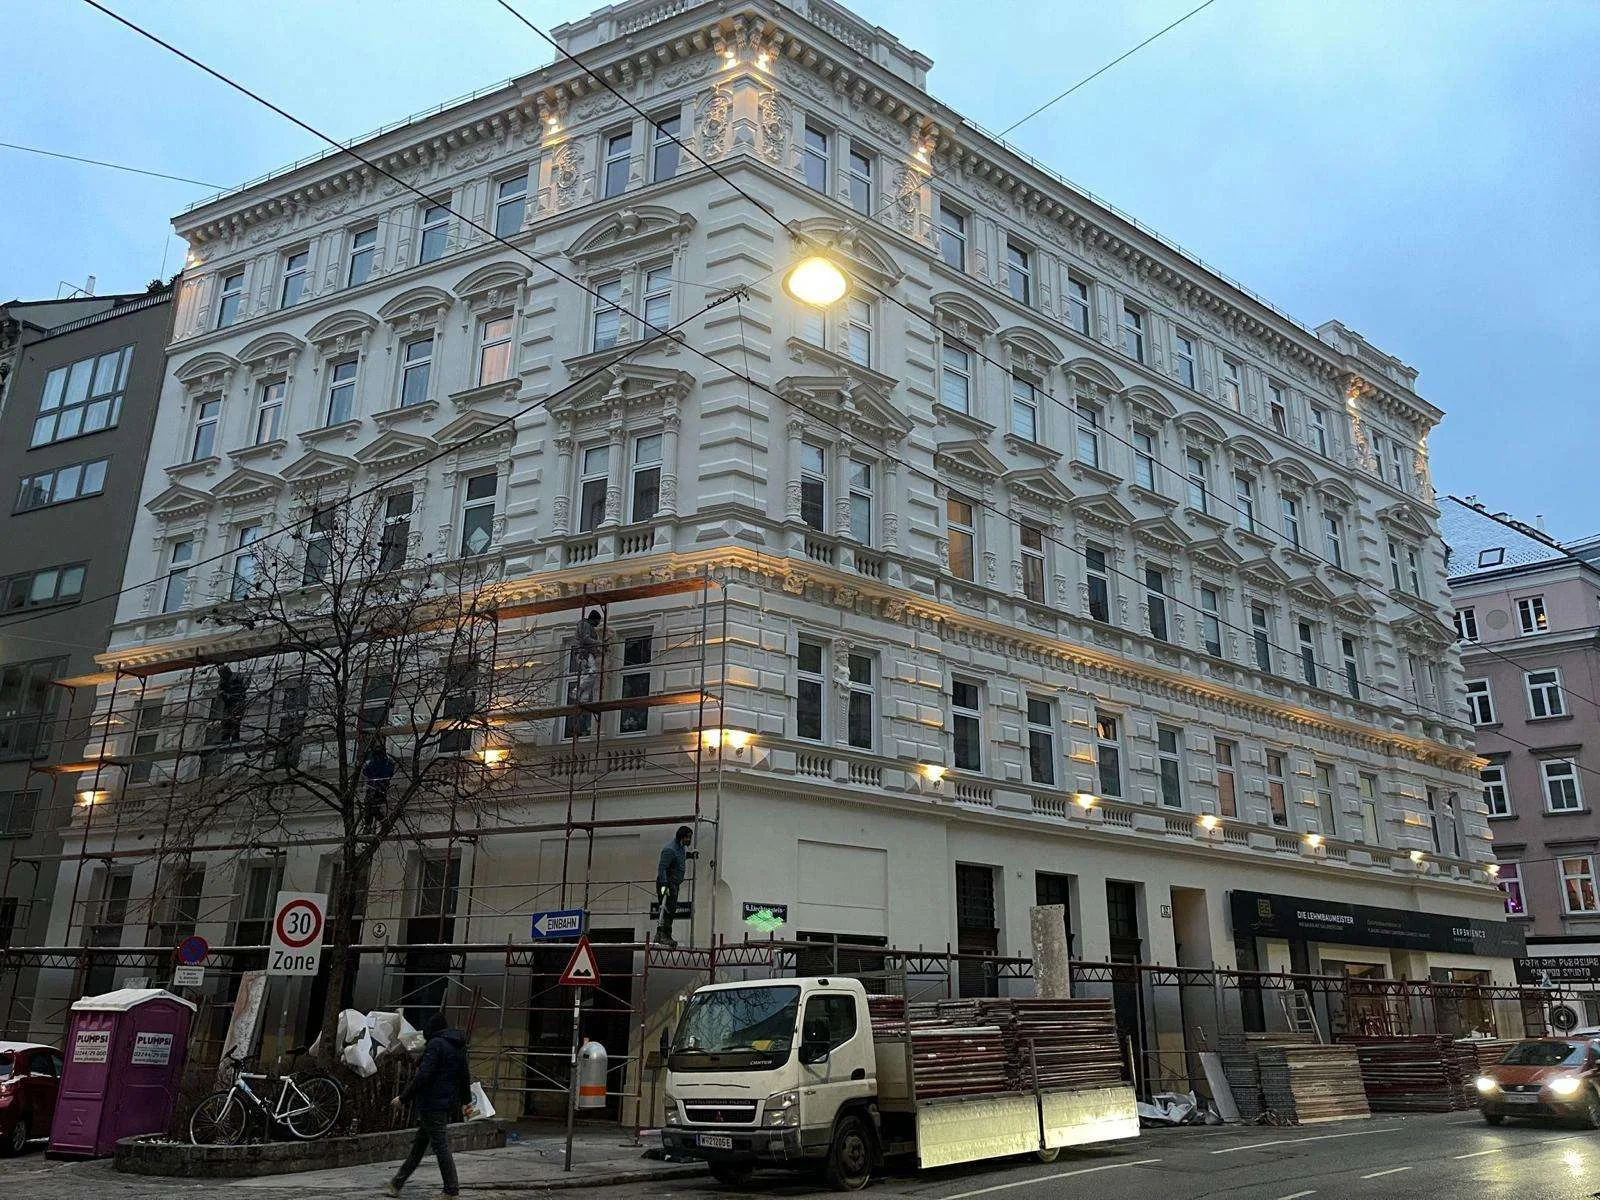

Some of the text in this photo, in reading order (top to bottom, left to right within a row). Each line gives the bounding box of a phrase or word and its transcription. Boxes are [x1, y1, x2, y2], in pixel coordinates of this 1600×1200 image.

[287, 912, 311, 935] 30
[548, 917, 577, 930] EINBAHN
[1297, 910, 1307, 919] DIE
[1307, 911, 1354, 924] LEHMBAUMEISTER
[272, 951, 315, 970] Zone
[1530, 968, 1561, 977] TATOO
[77, 1034, 109, 1043] PLUMPSI
[137, 1036, 171, 1046] PLUMPSI
